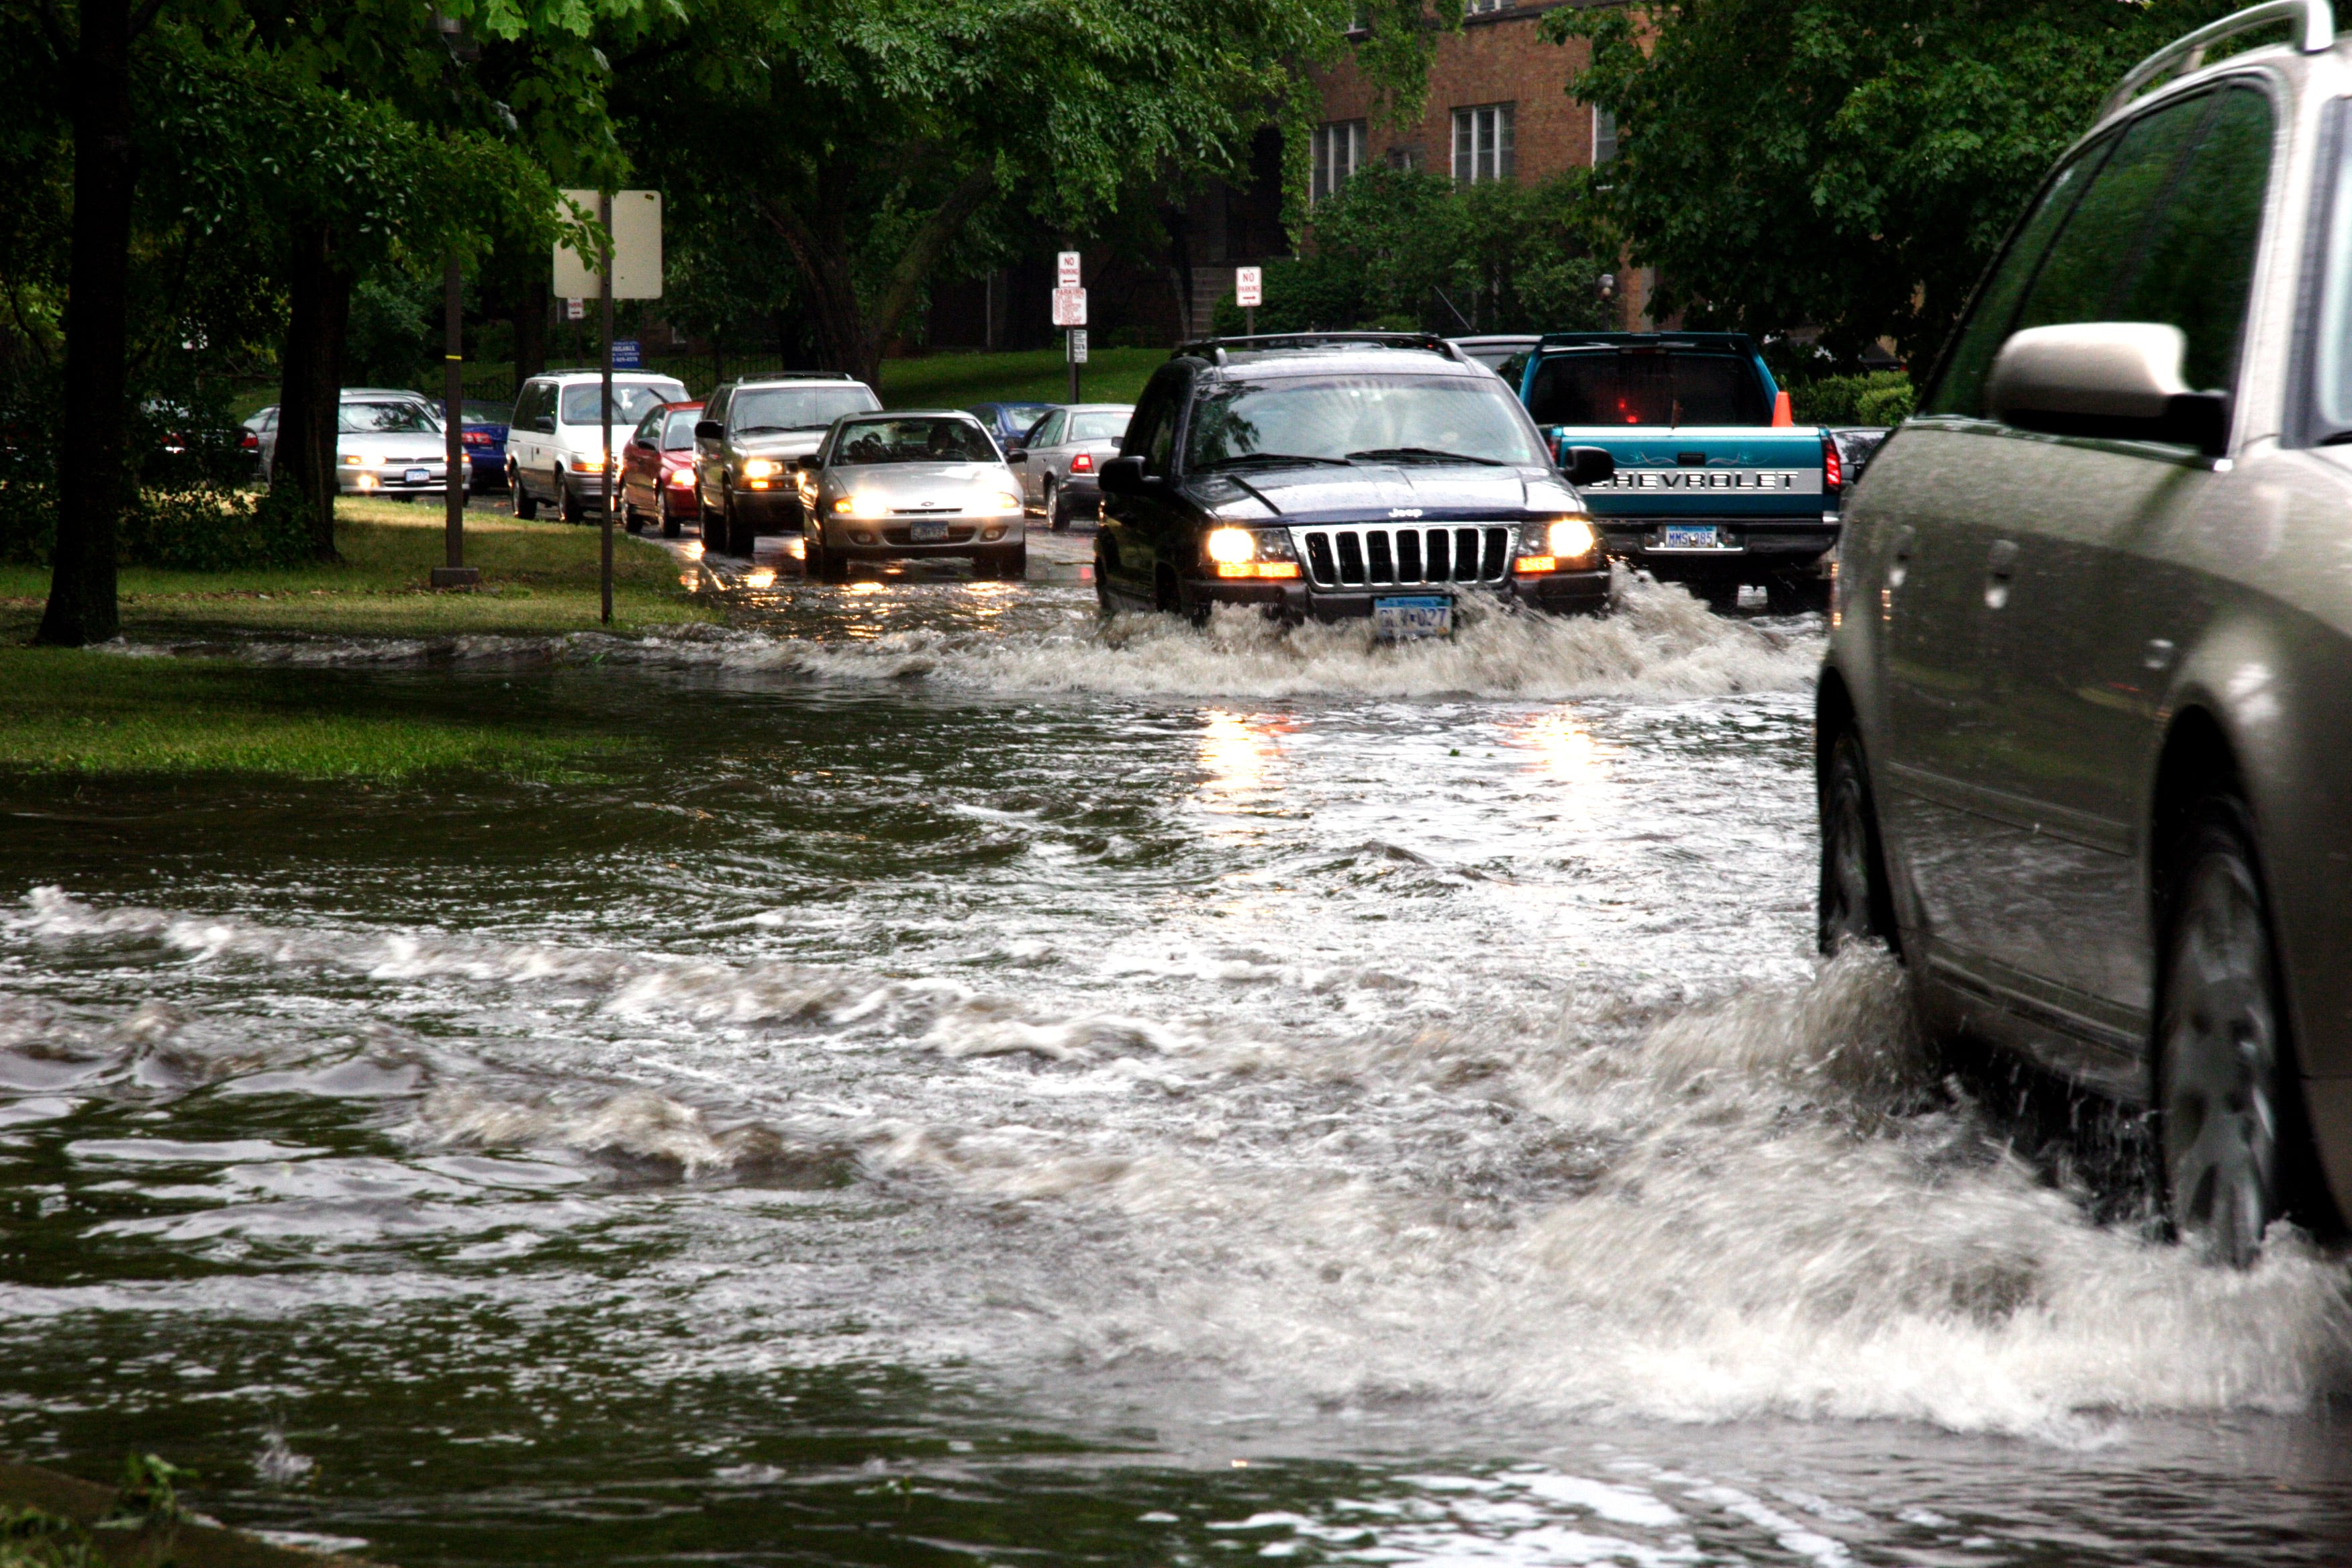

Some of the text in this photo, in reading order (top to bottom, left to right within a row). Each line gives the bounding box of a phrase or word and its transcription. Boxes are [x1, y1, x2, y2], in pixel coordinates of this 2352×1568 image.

[1064, 257, 1075, 266] NO
[1242, 273, 1255, 282] NO
[1388, 508, 1423, 518] Jeep
